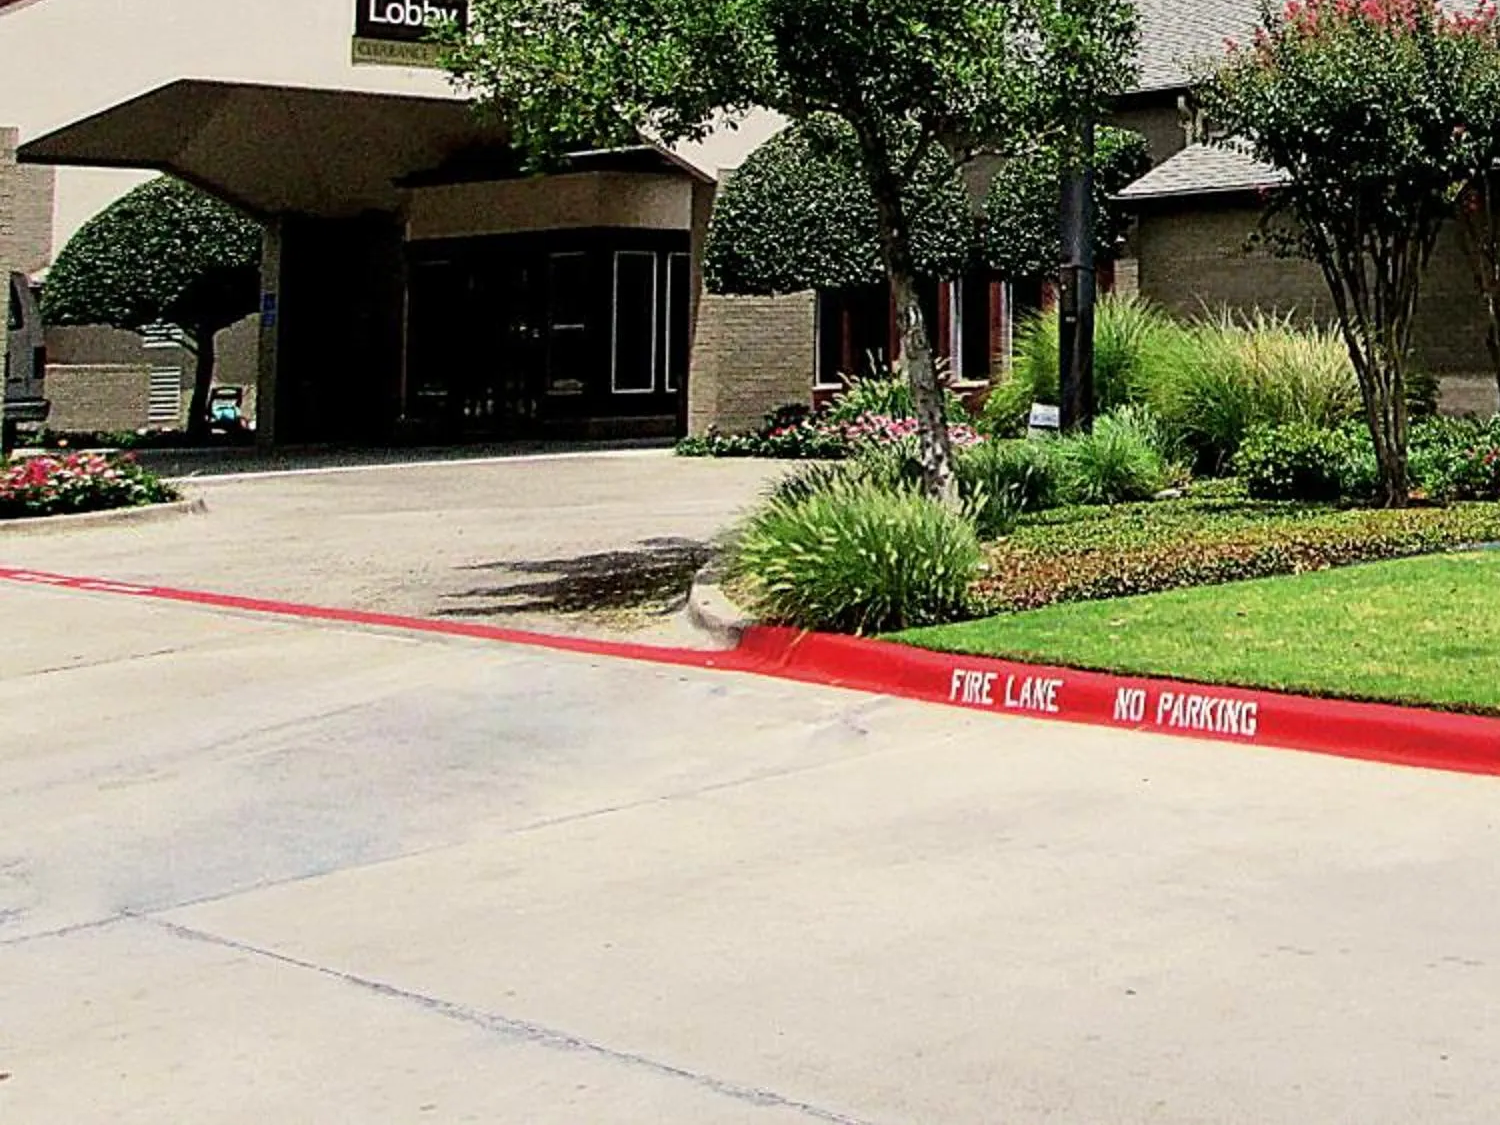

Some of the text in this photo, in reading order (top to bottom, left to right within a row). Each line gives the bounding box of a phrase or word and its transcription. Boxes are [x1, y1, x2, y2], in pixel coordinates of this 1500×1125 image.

[949, 669, 1064, 713] FIRE LANE
[1113, 687, 1258, 736] NO PARKING
